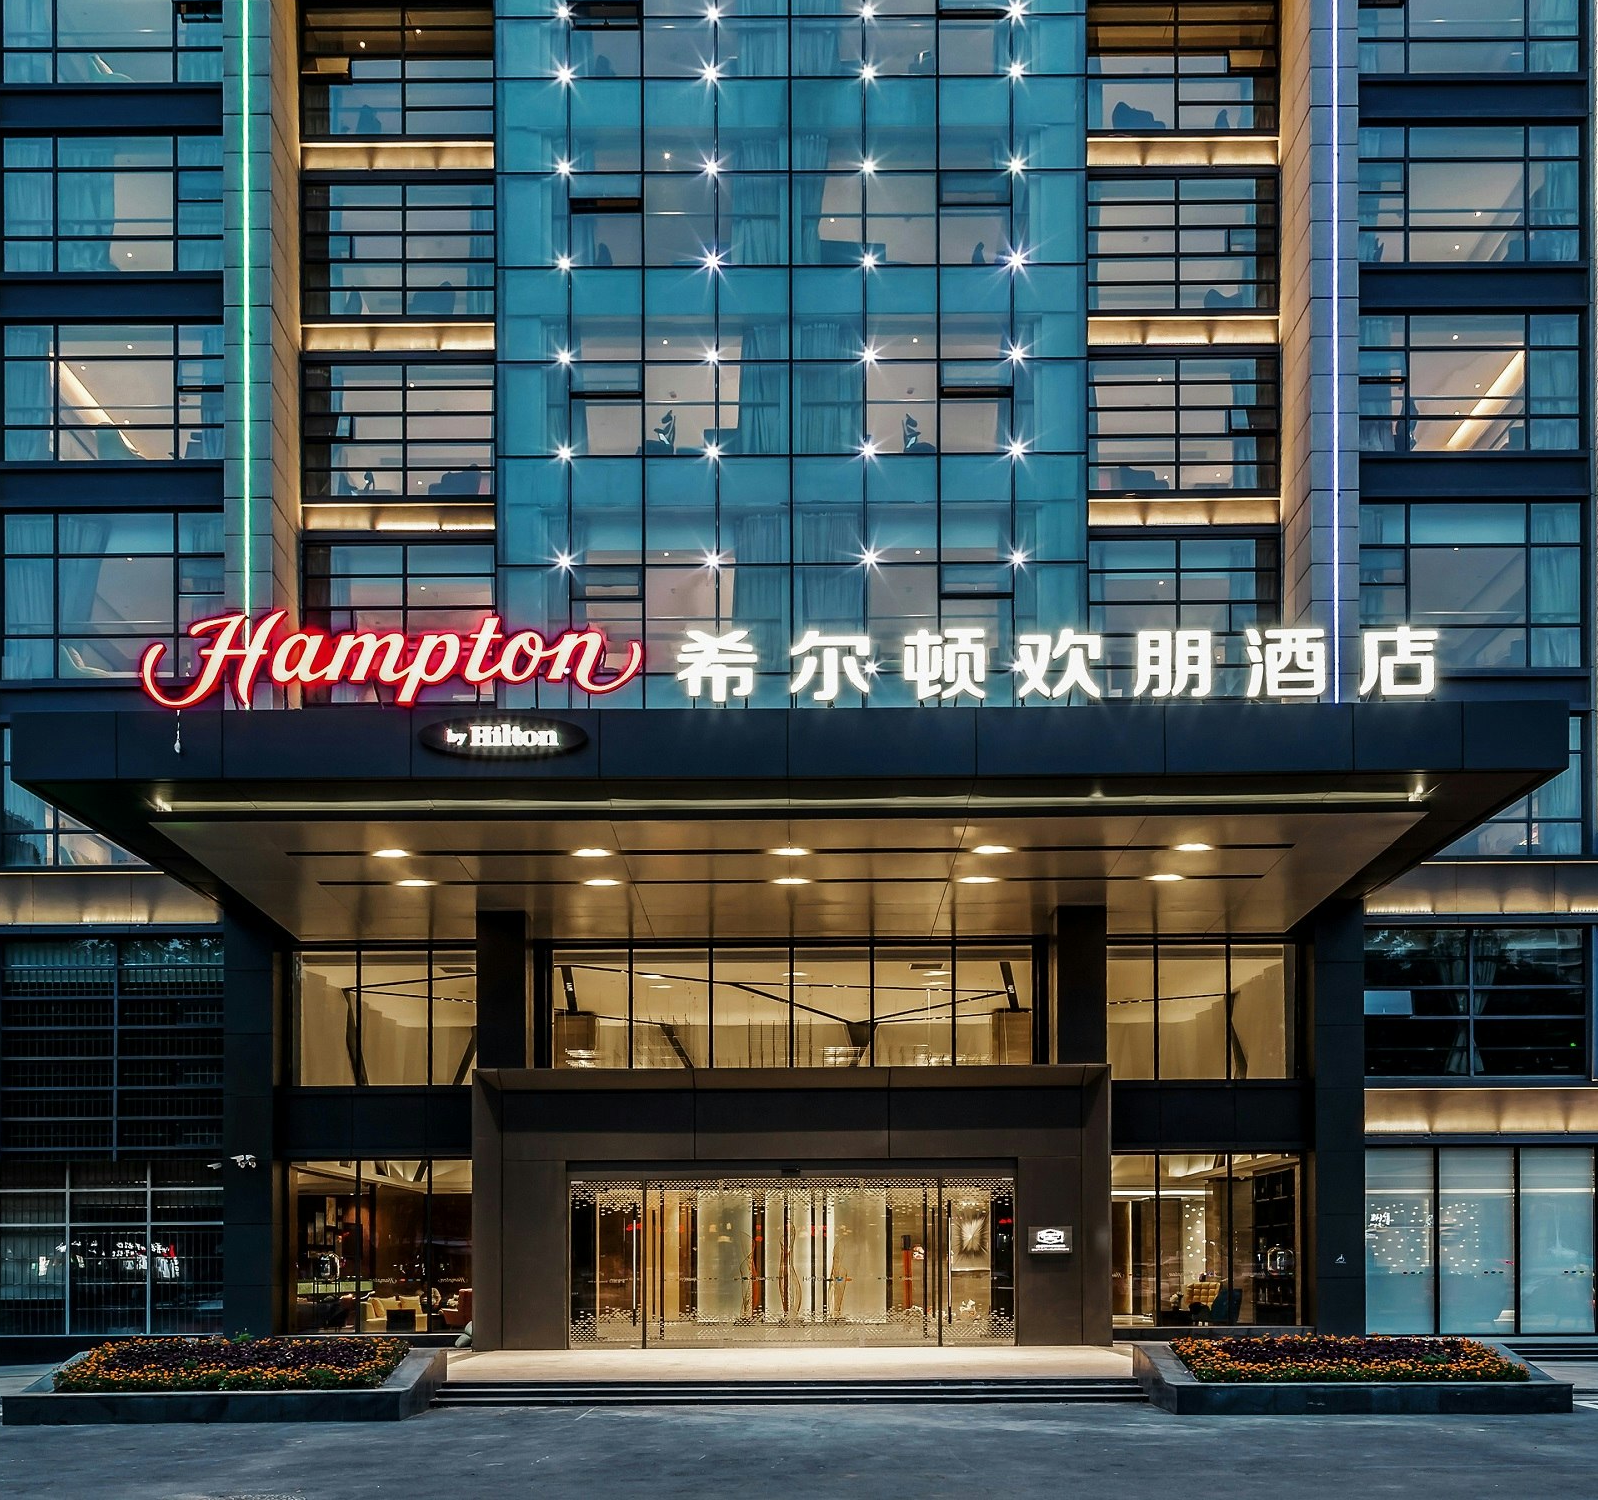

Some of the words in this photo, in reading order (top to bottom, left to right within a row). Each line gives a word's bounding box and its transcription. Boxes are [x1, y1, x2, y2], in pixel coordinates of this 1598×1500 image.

[141, 609, 644, 709] Hampton
[675, 626, 1443, 704] 希尔顿欢朋酒店
[445, 727, 468, 747] by
[469, 723, 561, 748] Hilton
